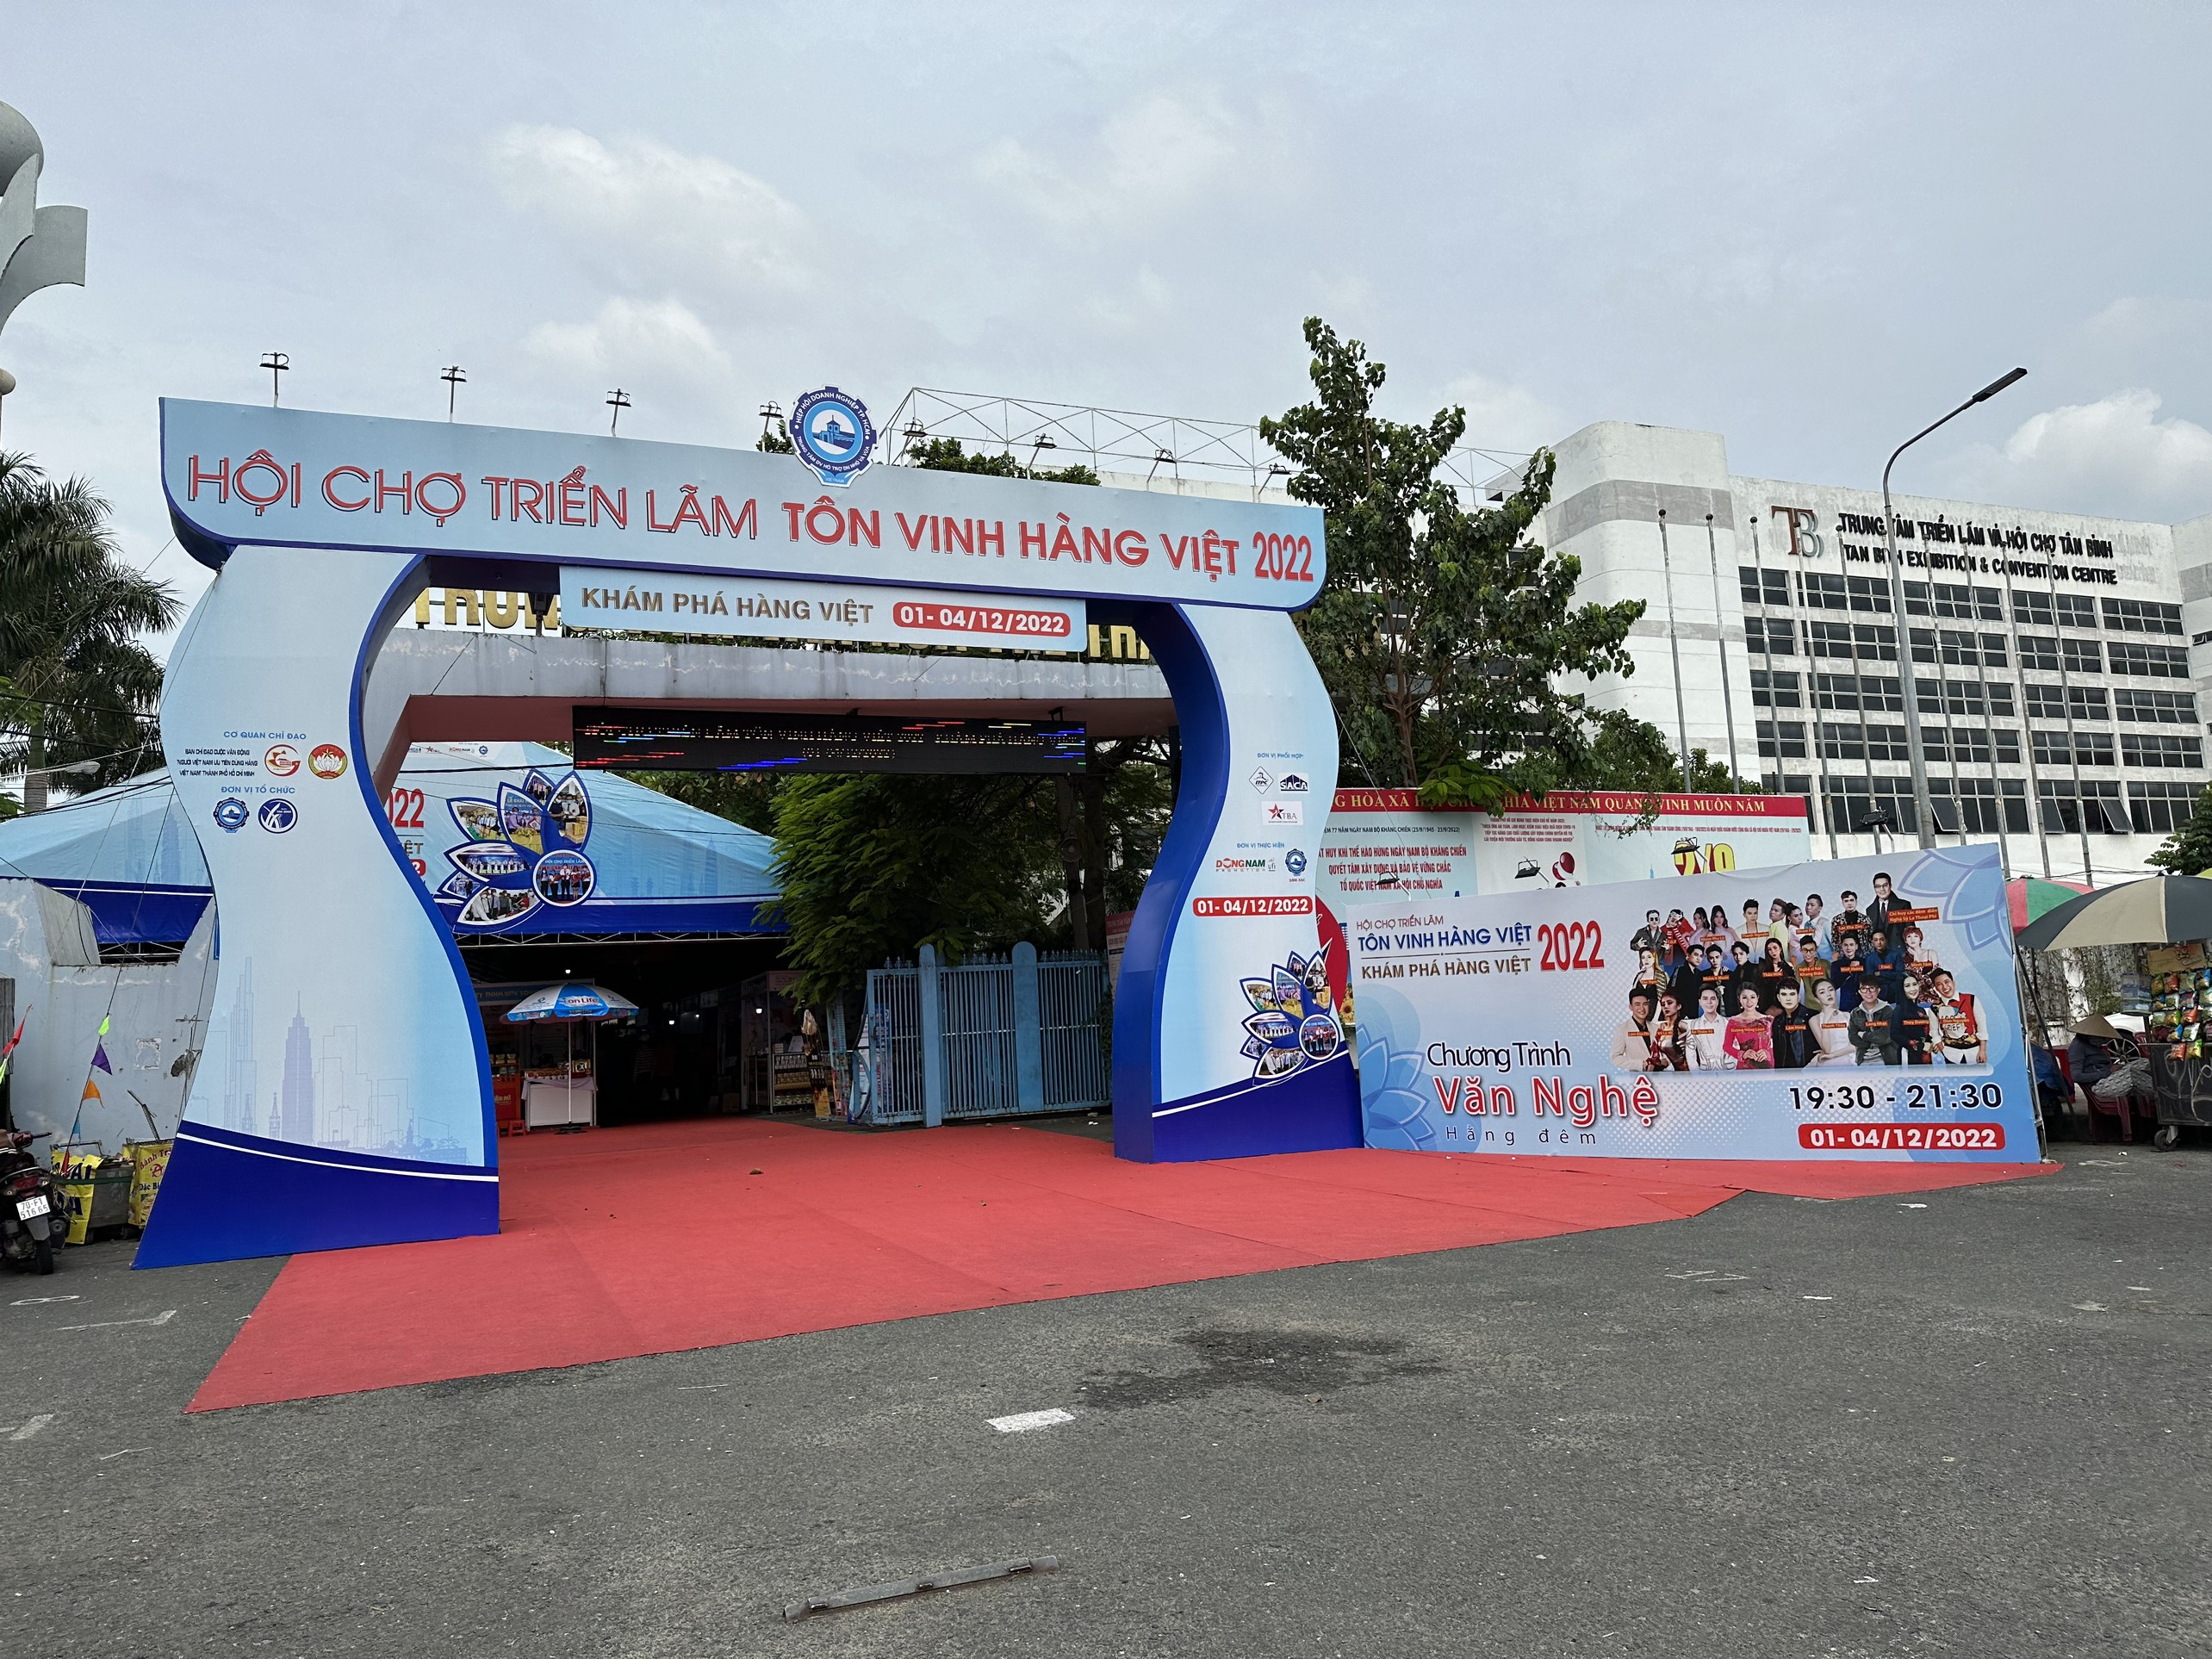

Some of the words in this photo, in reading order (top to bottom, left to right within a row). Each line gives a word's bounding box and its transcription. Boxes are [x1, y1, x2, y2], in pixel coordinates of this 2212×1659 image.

[811, 392, 835, 401] DOANH
[188, 449, 301, 516] HỘI
[322, 466, 466, 527] CHỢ
[482, 465, 627, 530] TRIỂN
[647, 485, 757, 540] LÃM
[782, 496, 881, 550] TÔN
[895, 512, 1006, 559] VINH
[1019, 512, 1149, 568] HÀNG
[1160, 536, 1240, 582] VIỆT
[1252, 531, 1314, 583] 2022
[1838, 513, 1885, 536] TRUNG
[1917, 514, 1956, 543] TRIỂN
[1986, 523, 2004, 546] VÀ
[2005, 525, 2028, 554] HỘI
[2030, 532, 2056, 557] CHỢ
[2059, 531, 2084, 556] TÂN
[2085, 534, 2114, 559] BÌNH
[1843, 544, 1869, 562] TAN
[1980, 557, 1989, 573] &
[1992, 558, 2070, 580] CONVENTON
[2072, 566, 2117, 585] CENTRE
[581, 587, 663, 613] KHÁM
[673, 591, 725, 615] PHÁ
[736, 591, 811, 620] HÀNG
[819, 598, 873, 627] VIỆT
[940, 609, 1066, 634] 04/12/2022
[268, 730, 285, 739] CHỈ
[287, 733, 307, 742] ĐẠO
[244, 786, 253, 795] VỊ
[255, 784, 266, 793] TỔ
[269, 785, 295, 794] CHỨC
[1280, 781, 1307, 790] SACA
[1351, 791, 1384, 807] HÒA
[1389, 792, 1410, 807] XÃ
[1570, 797, 1600, 809] NAM
[1694, 796, 1732, 812] MUÔN
[1736, 798, 1765, 812] NĂM
[1326, 848, 1336, 858] HUY
[1349, 845, 1359, 857] THẾ
[1390, 844, 1405, 857] NGÀY
[1407, 847, 1420, 857] NAM
[1421, 845, 1429, 859] BỘ
[1430, 844, 1449, 857] KHÁNG
[1450, 843, 1466, 856] CHIẾN
[1329, 861, 1346, 875] QUYẾT
[1347, 862, 1359, 874] TÂM
[1361, 862, 1372, 874] XÂY
[1349, 877, 1364, 892] QUỐC
[1223, 898, 1308, 915] 04/12/2022
[1357, 919, 1372, 930] HỘI
[1375, 917, 1396, 930] CHỢ
[1398, 914, 1421, 927] TRIỂN
[1424, 915, 1444, 926] LÃM
[1358, 932, 1390, 952] TÔN
[1395, 931, 1434, 948] VINH
[1438, 925, 1491, 946] HÀNG
[1496, 922, 1532, 947] VIỆT
[1538, 921, 1605, 972] 2022
[1361, 961, 1404, 979] KHÁM
[1408, 959, 1439, 978] PHÁ
[1445, 957, 1490, 975] HÀNG
[1494, 954, 1532, 975] VIỆT
[1427, 1042, 1512, 1072] Chương
[1513, 1041, 1572, 1066] Trình
[1433, 1075, 1515, 1115] Văn
[1532, 1074, 1659, 1128] Nghệ
[1790, 1085, 1875, 1109] 19:30
[1906, 1083, 2004, 1109] 21:30
[1446, 1125, 1514, 1146] Hằng
[1538, 1128, 1596, 1145] đêm
[1852, 1128, 1998, 1149] 04/12/2022
